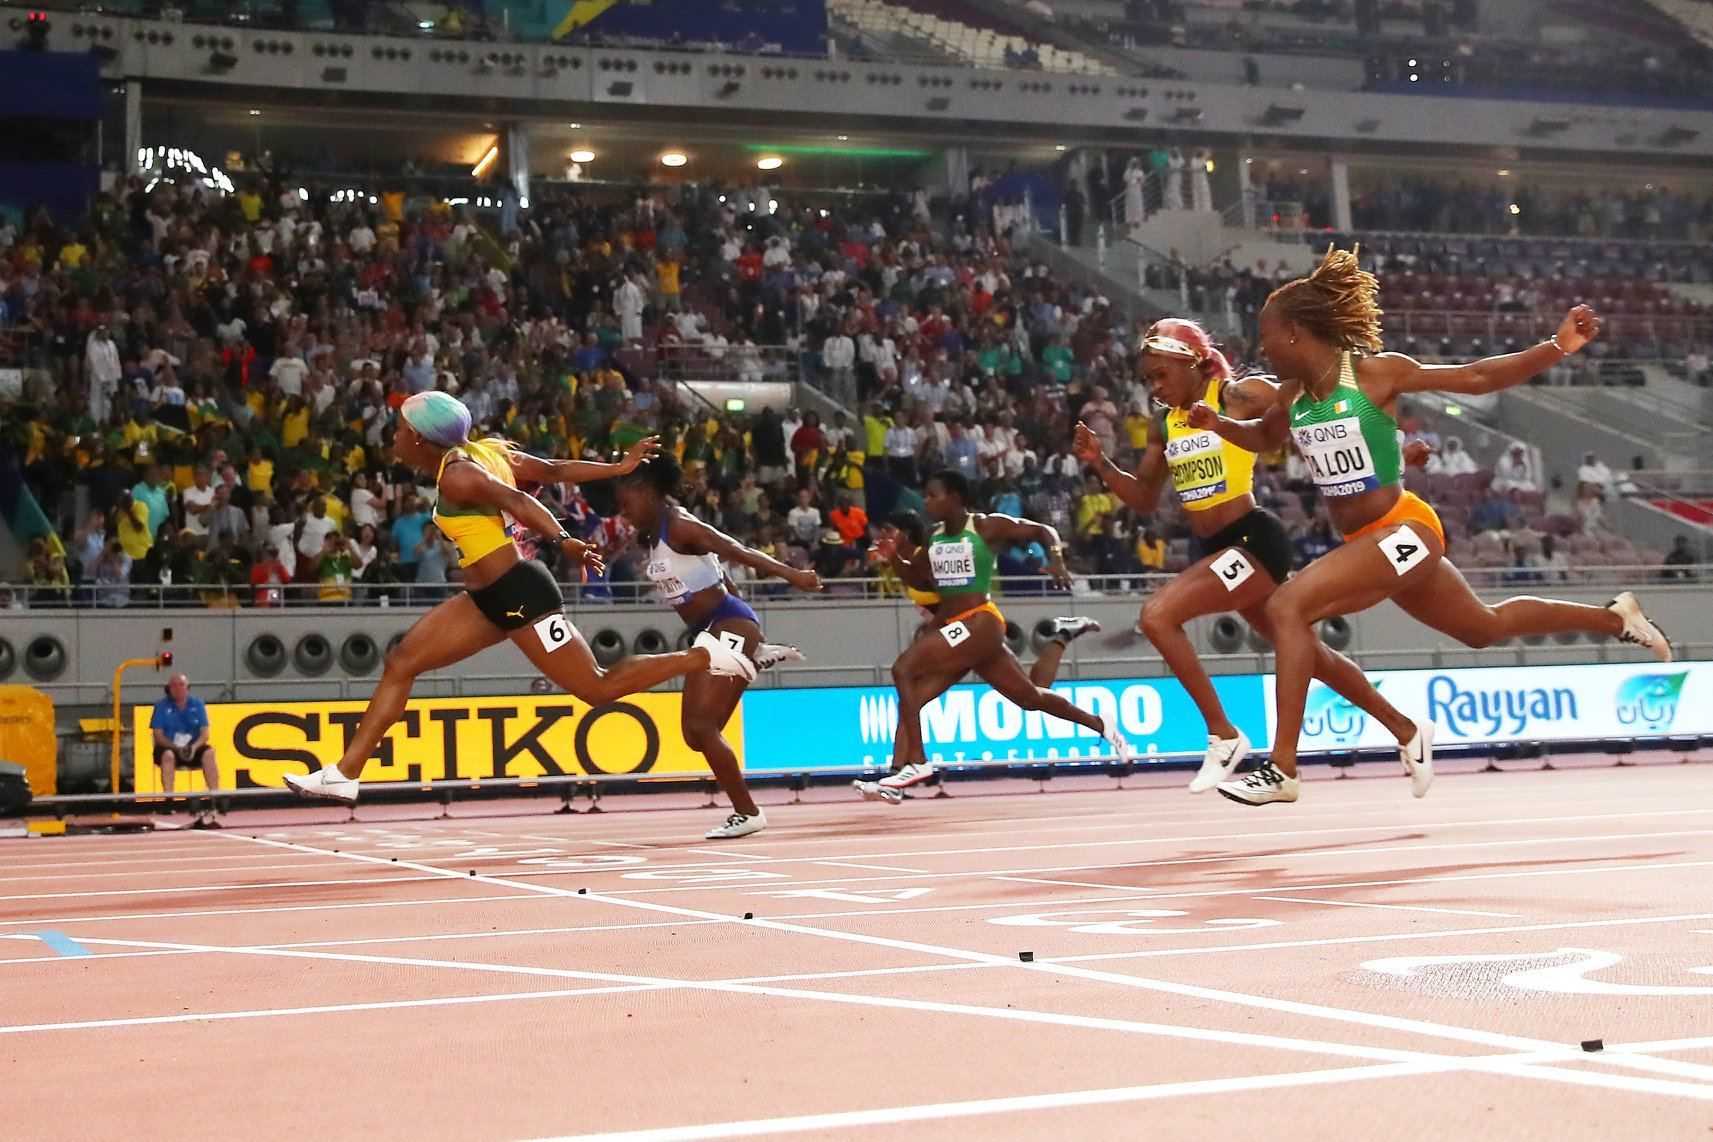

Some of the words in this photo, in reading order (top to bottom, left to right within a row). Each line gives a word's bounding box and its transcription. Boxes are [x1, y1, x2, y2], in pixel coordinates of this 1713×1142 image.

[1314, 424, 1347, 442] QNB
[1181, 436, 1210, 452] QNB
[1325, 446, 1366, 476] LOU
[1395, 544, 1418, 563] 4
[1222, 559, 1245, 580] 5
[549, 620, 565, 642] 6
[948, 627, 963, 639] 8
[728, 638, 739, 650] 7
[918, 684, 1163, 744] MONDO
[1428, 674, 1578, 737] Rayyan
[233, 701, 660, 789] SEIKO
